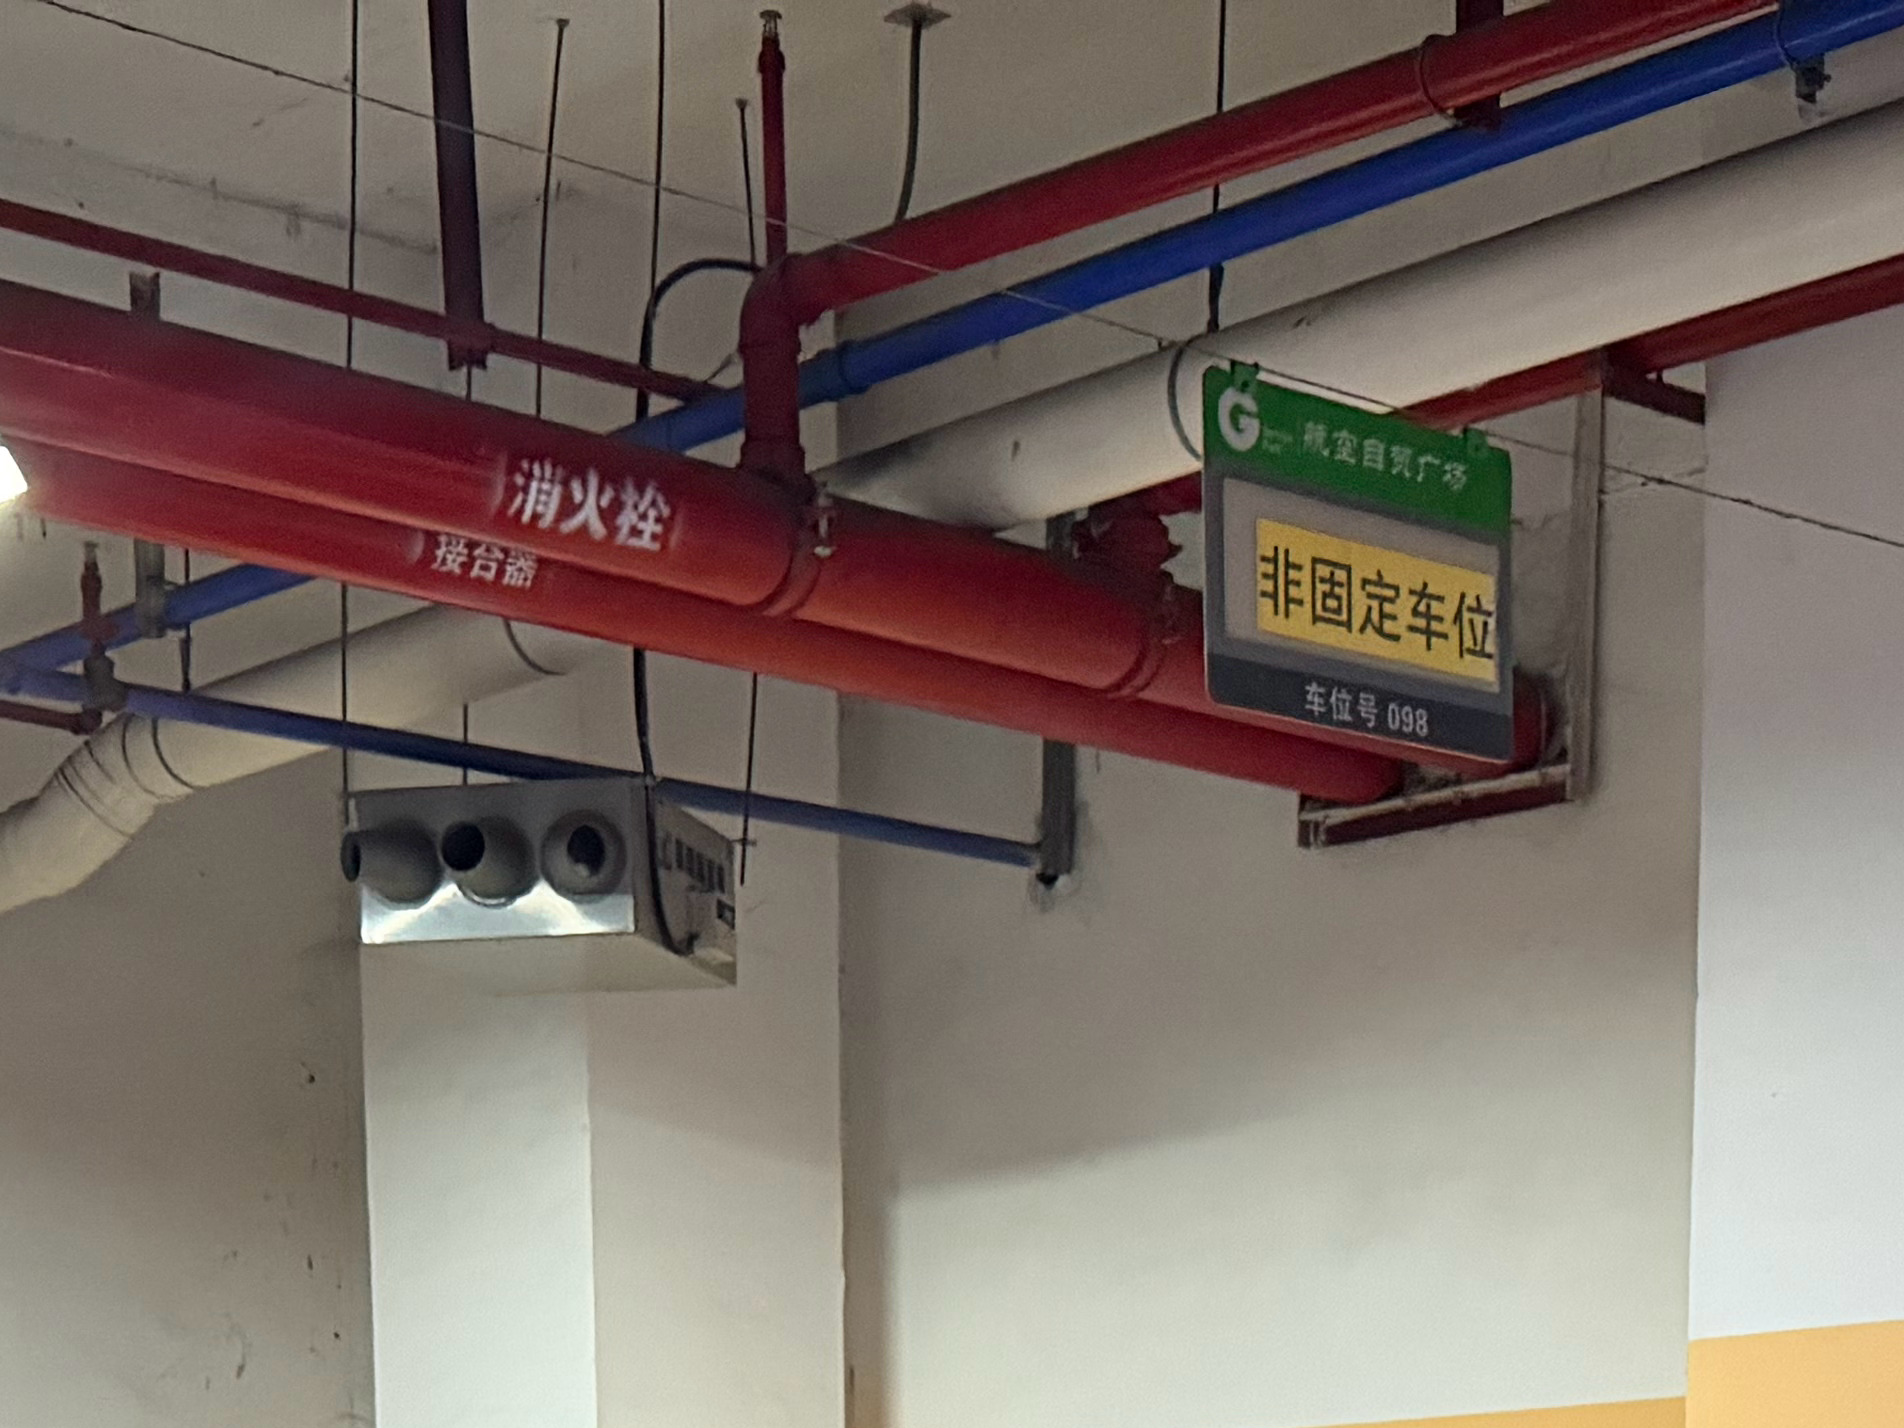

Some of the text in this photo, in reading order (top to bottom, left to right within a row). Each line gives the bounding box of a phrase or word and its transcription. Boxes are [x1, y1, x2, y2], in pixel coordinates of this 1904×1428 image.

[506, 457, 672, 552] 消火栓
[1259, 545, 1495, 660] 非固定车位
[1304, 681, 1430, 737] 车位号 098
